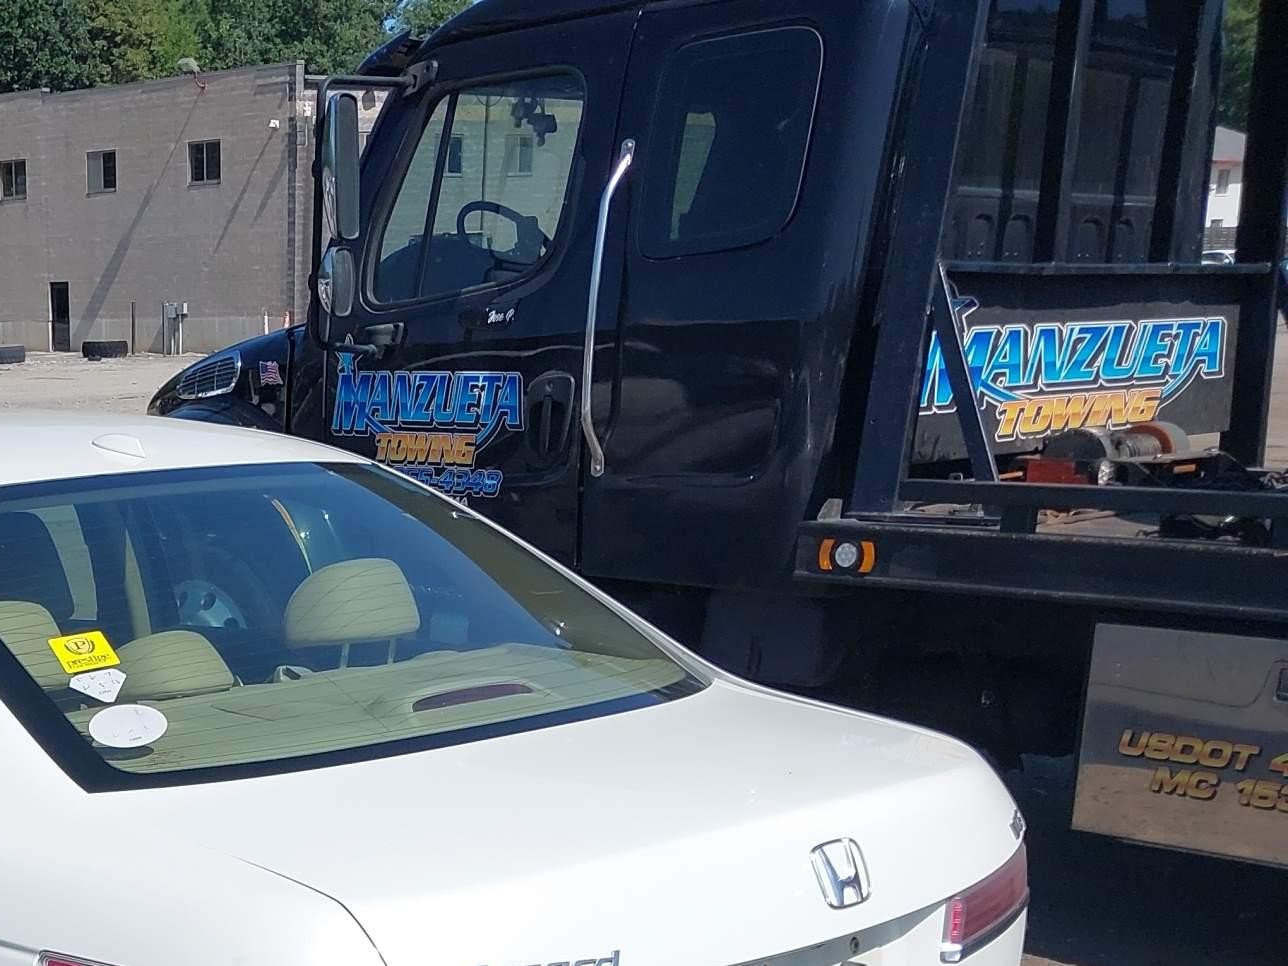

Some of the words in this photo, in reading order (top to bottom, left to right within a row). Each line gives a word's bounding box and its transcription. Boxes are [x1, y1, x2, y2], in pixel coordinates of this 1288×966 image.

[919, 317, 1227, 415] MANZUETA
[331, 370, 525, 436] MANZUETA
[996, 388, 1163, 442] TOWING
[375, 432, 478, 467] TOWING
[1118, 728, 1261, 772] USDOT
[1150, 766, 1219, 800] MC
